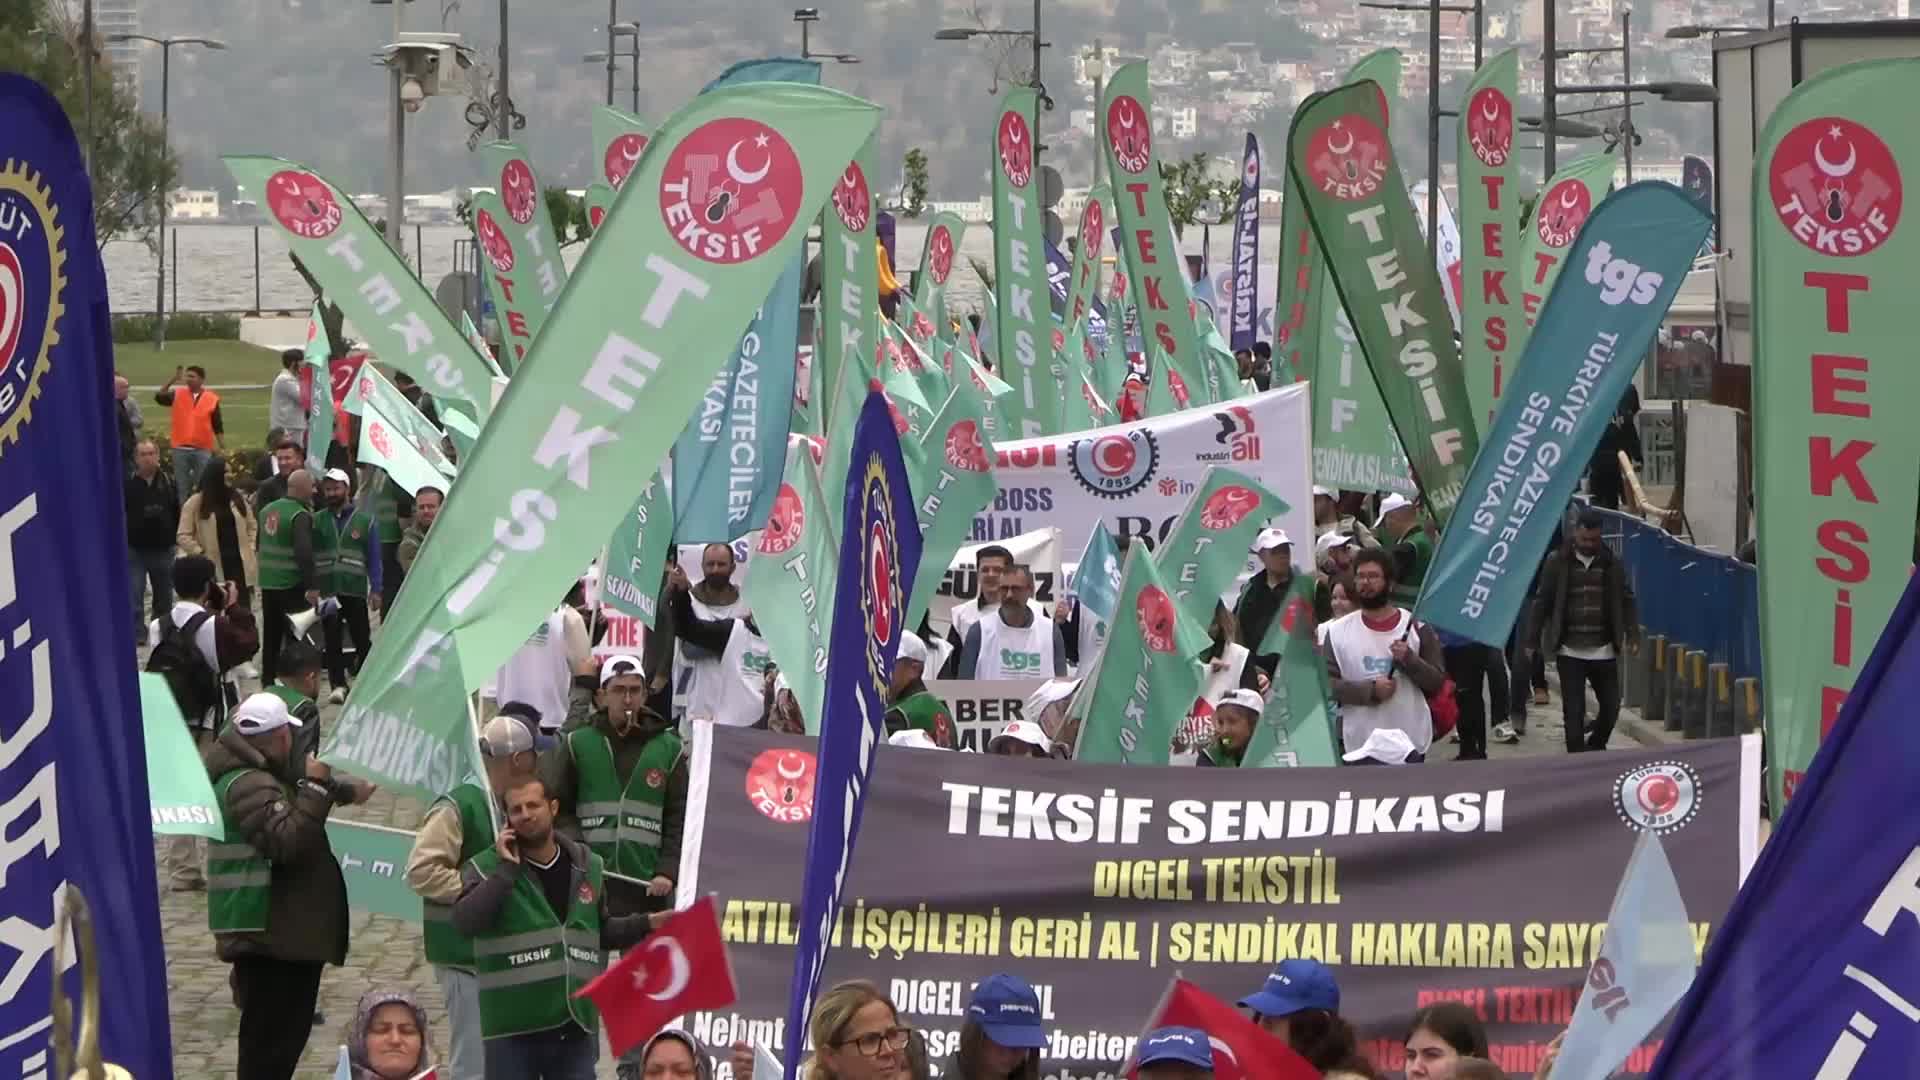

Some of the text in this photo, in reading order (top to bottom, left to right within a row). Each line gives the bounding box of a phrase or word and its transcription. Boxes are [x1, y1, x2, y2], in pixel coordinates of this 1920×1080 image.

[1584, 239, 1664, 305] tgs
[728, 332, 761, 524] GAZETECİLER
[1460, 330, 1618, 619] TÜRKİYE GAZETECİLER
[1469, 390, 1551, 535] SENDİKASI
[993, 487, 1053, 512] BOSS
[607, 616, 638, 647] THE
[1000, 647, 1041, 670] tgs
[335, 704, 458, 794] ENDİKASI
[942, 782, 1505, 844] TEKSİF SENDİKASI
[1094, 849, 1341, 904] DIGEL TEKSTİL
[508, 947, 552, 966] TEKSİF
[851, 898, 1001, 961] İŞÇİLERİ
[1010, 911, 1092, 960] GERİ
[1098, 922, 1141, 961] AL
[1169, 917, 1342, 966] SENDİKAL
[1351, 922, 1515, 968] HAKLARA
[890, 978, 964, 1016] DIGEL
[693, 1011, 785, 1051] Nehmt
